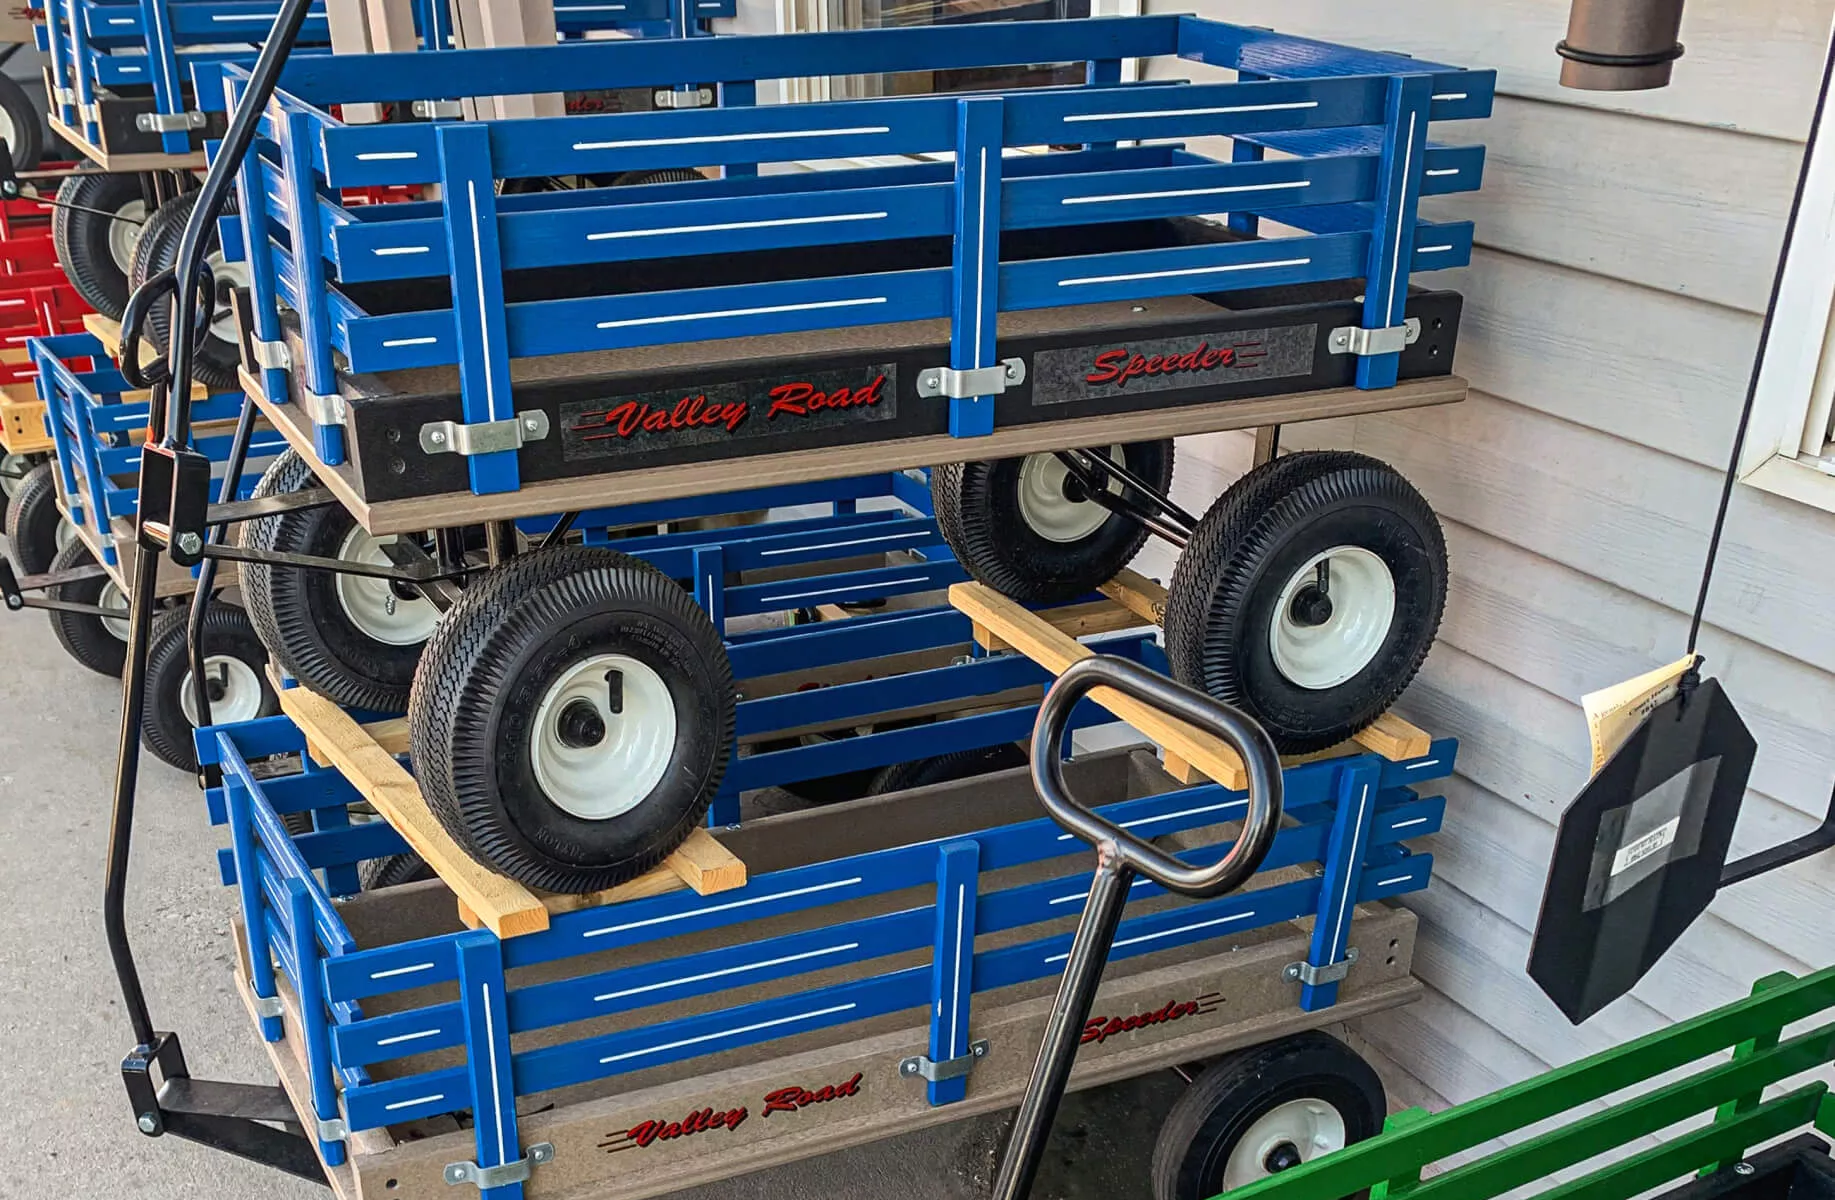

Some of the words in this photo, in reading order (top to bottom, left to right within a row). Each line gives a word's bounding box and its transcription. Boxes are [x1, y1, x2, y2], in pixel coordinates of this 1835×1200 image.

[1085, 341, 1235, 386] Speeder
[604, 394, 748, 439] Valley
[766, 374, 885, 418] Road
[1080, 1000, 1198, 1043] Speeder
[627, 1105, 748, 1148] Valley
[761, 1071, 863, 1118] Road
